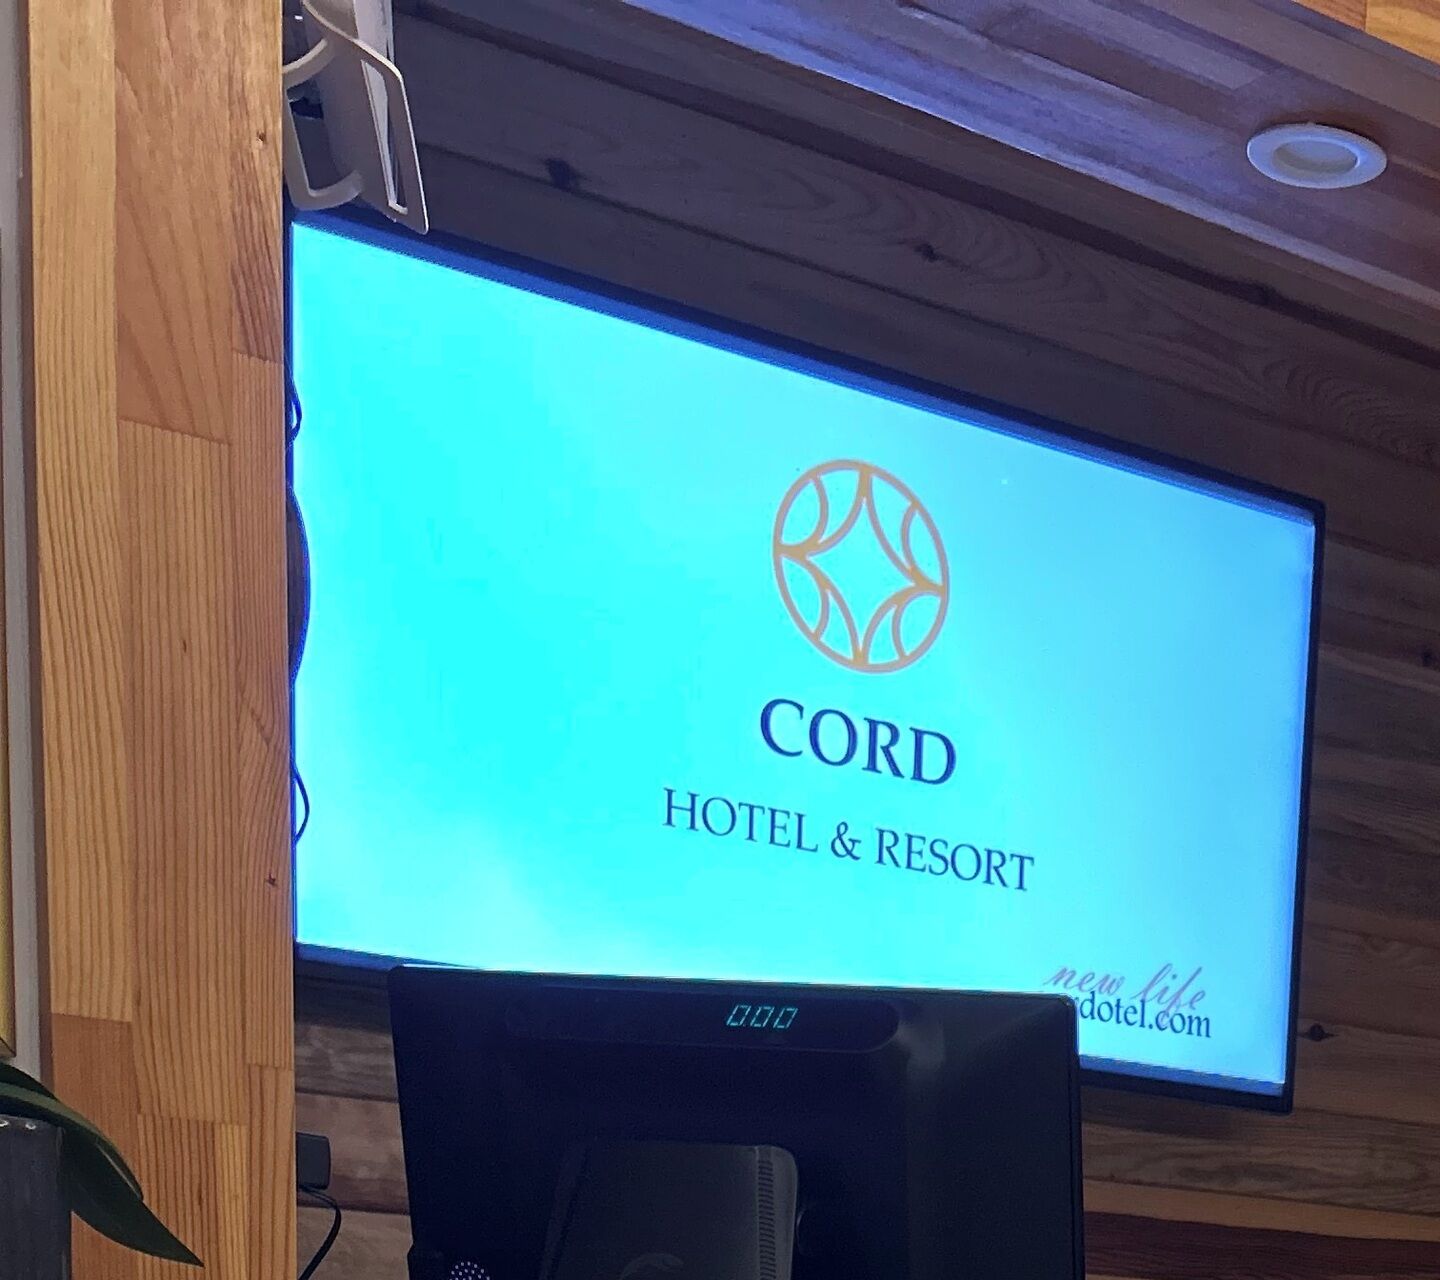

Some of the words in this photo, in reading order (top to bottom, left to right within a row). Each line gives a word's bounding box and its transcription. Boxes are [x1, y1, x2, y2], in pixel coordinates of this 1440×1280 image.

[759, 697, 957, 786] CORD
[662, 786, 818, 854] HOTEL
[830, 821, 861, 861] &
[875, 826, 1035, 893] RESORT
[1043, 965, 1126, 996] new
[1131, 963, 1206, 1022] life
[1074, 990, 1212, 1038] dotel.com
